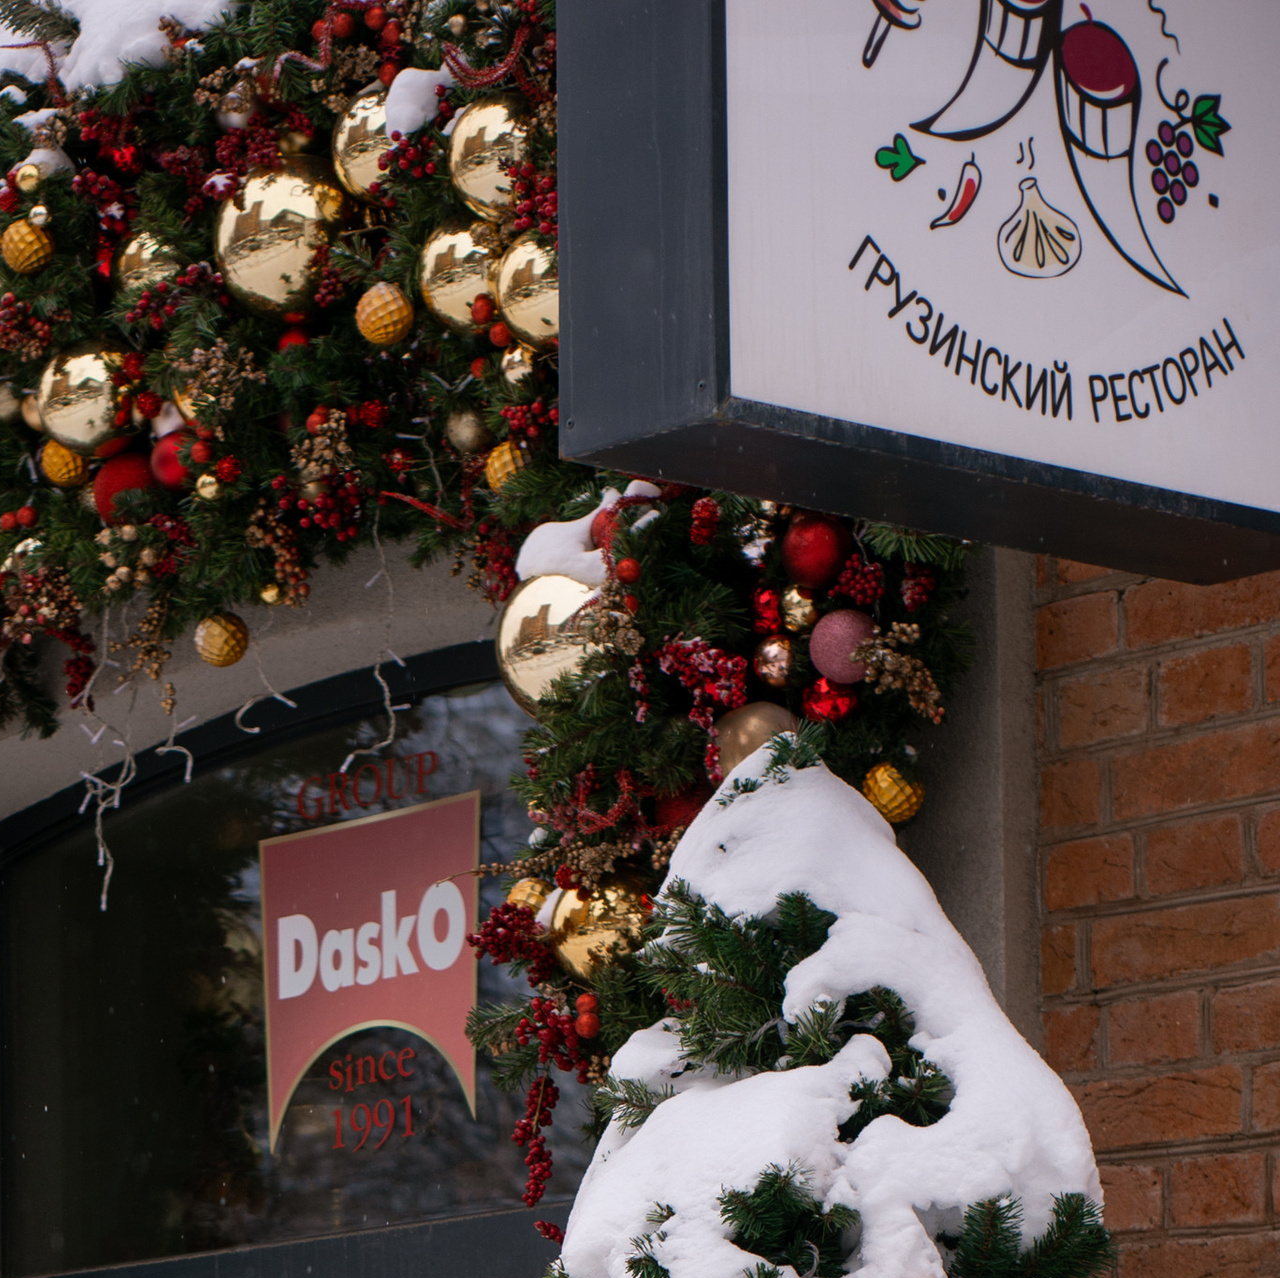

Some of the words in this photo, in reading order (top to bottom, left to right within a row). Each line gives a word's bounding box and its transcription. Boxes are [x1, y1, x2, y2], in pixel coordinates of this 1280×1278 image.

[848, 234, 1073, 421] ГРУЗИНСКИЙ
[1088, 317, 1246, 423] РЕСТОРАН
[296, 750, 439, 820] GROUP
[277, 879, 467, 1000] DaskO
[328, 1045, 416, 1092] since
[331, 1094, 417, 1154] 1991
